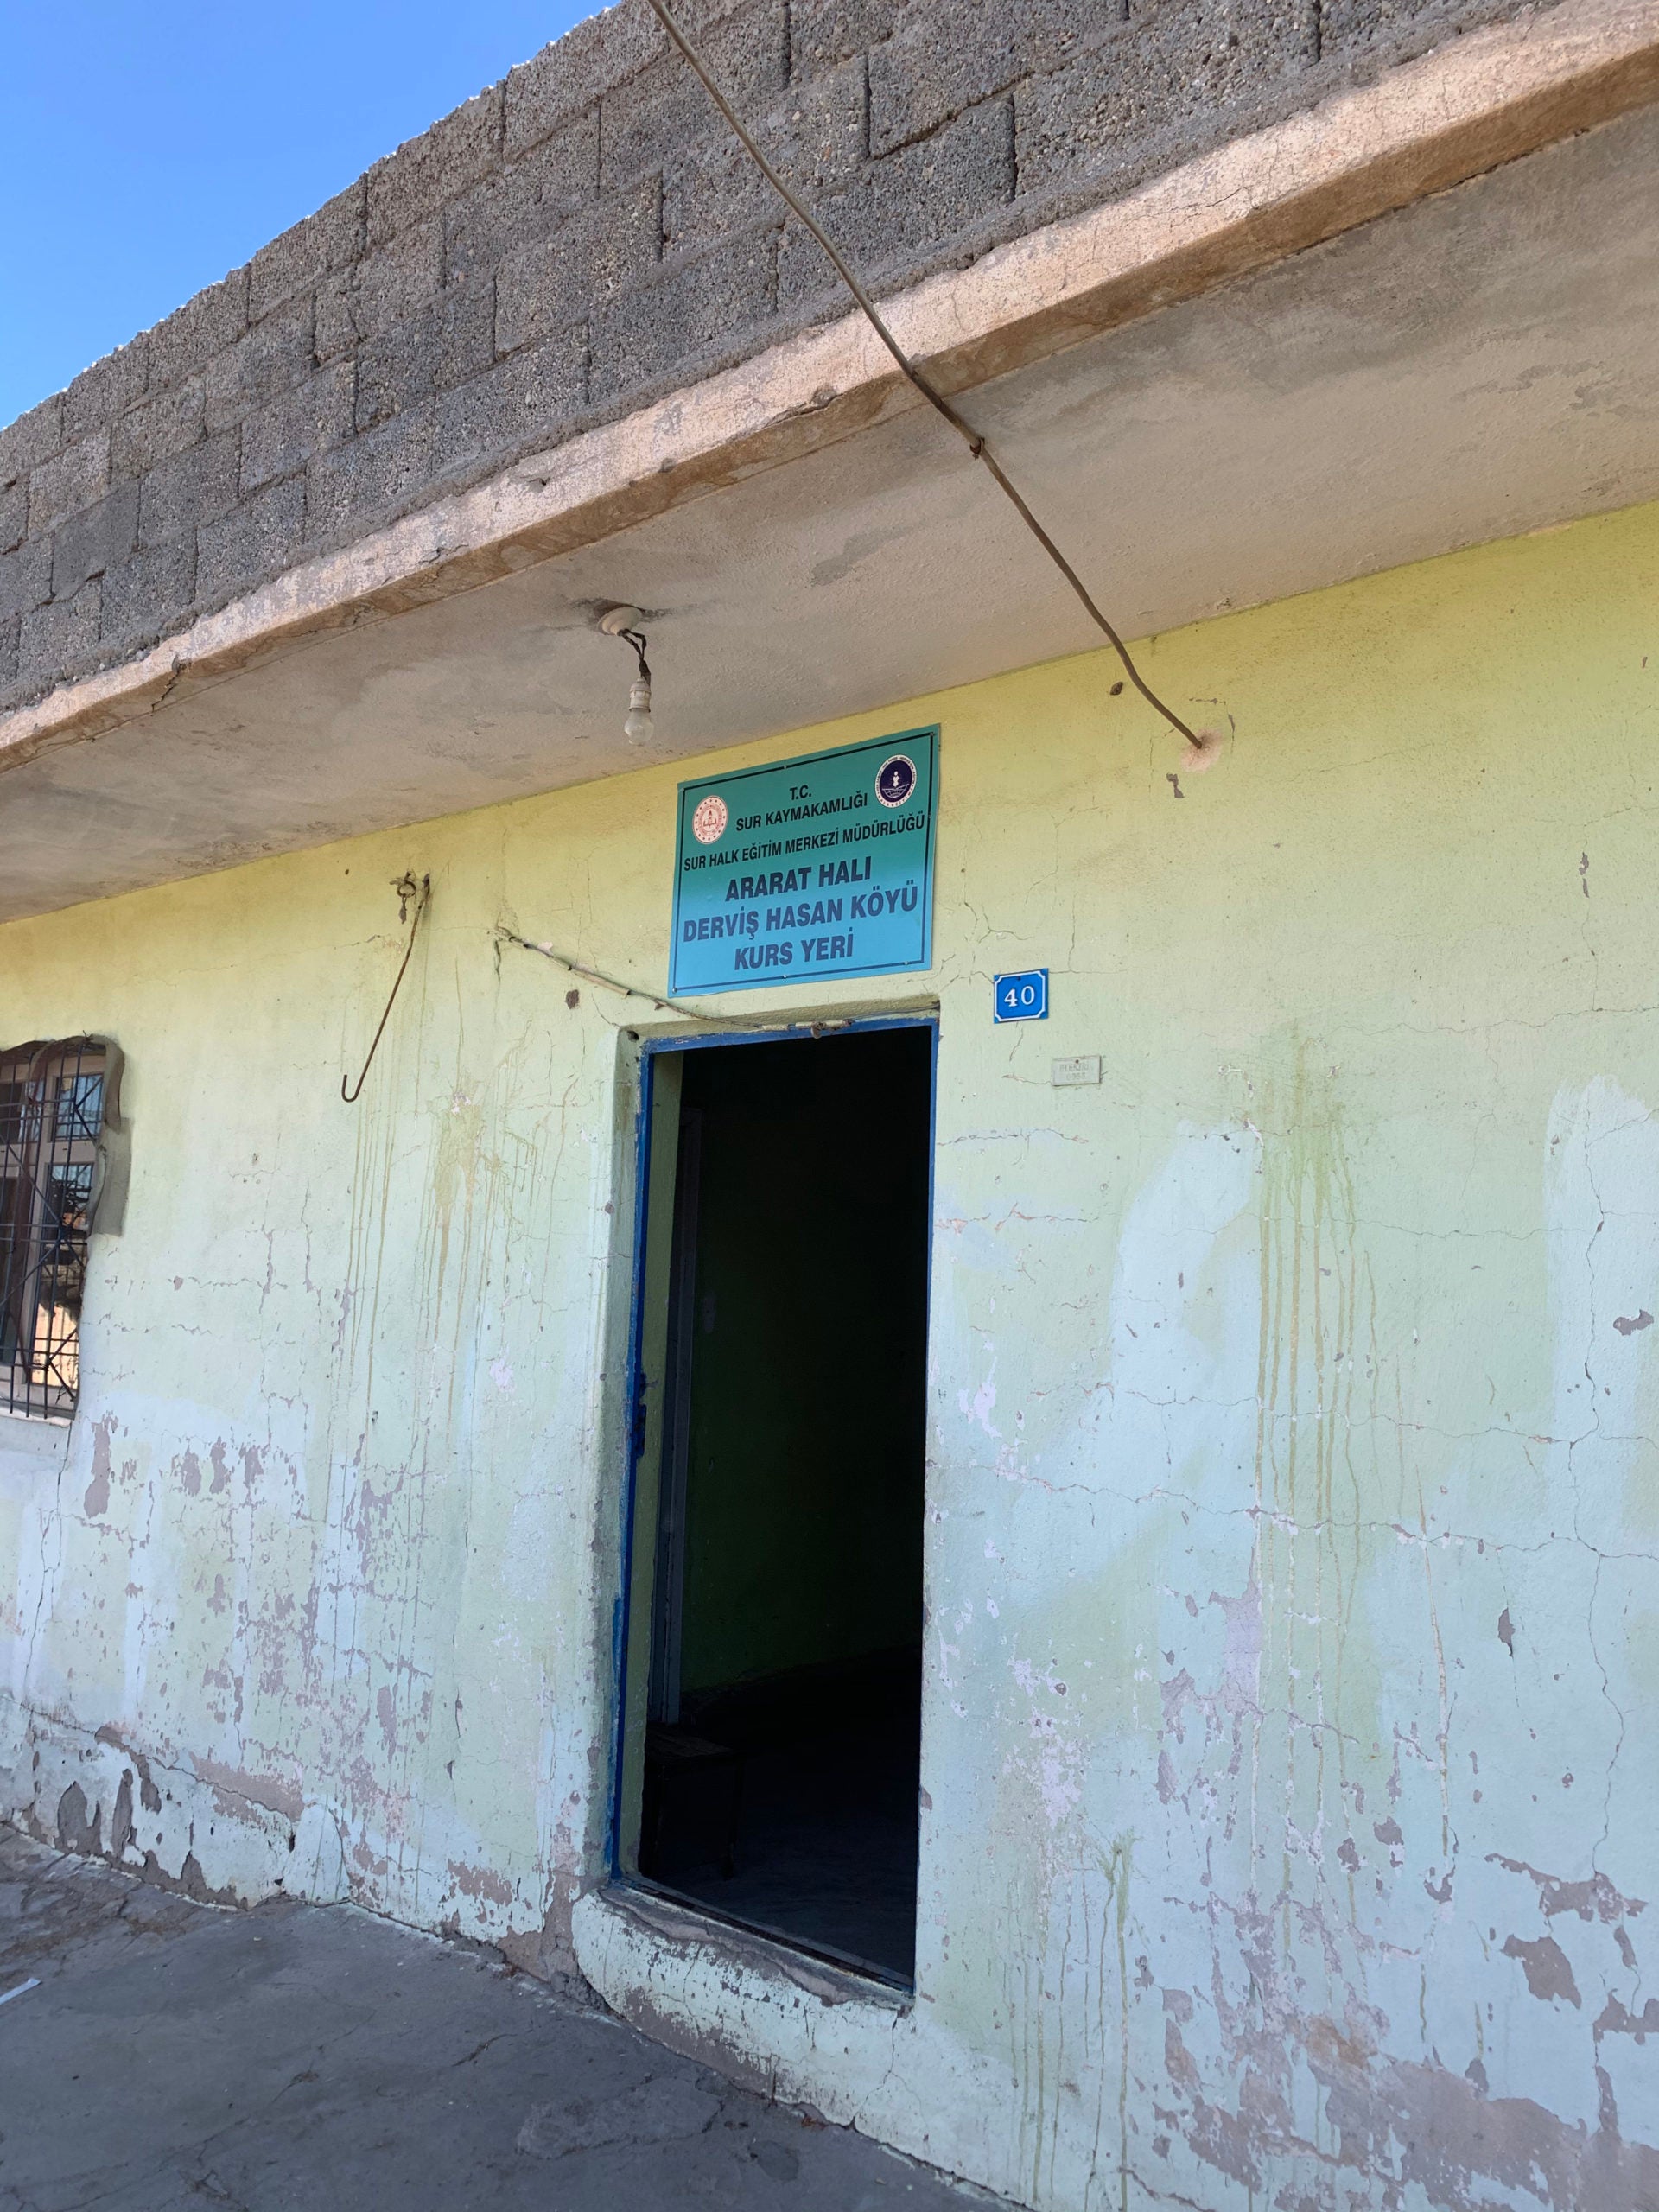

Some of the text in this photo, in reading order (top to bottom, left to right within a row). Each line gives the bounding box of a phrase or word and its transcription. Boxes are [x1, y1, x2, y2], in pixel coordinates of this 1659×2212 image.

[735, 814, 762, 831] SUR
[766, 790, 868, 827] KAYMAKAMLIĞI
[790, 785, 812, 800] T.C.
[683, 810, 925, 872] SUR HALK EĞİTİM MERKEZİ MÜDÜRLÜĞÜ
[724, 855, 872, 902] ARARAT HALI
[683, 879, 918, 943] DERVİŞ HASAN KÖYÜ
[734, 926, 854, 971] KURS YERİ
[1004, 985, 1035, 1007] 40
